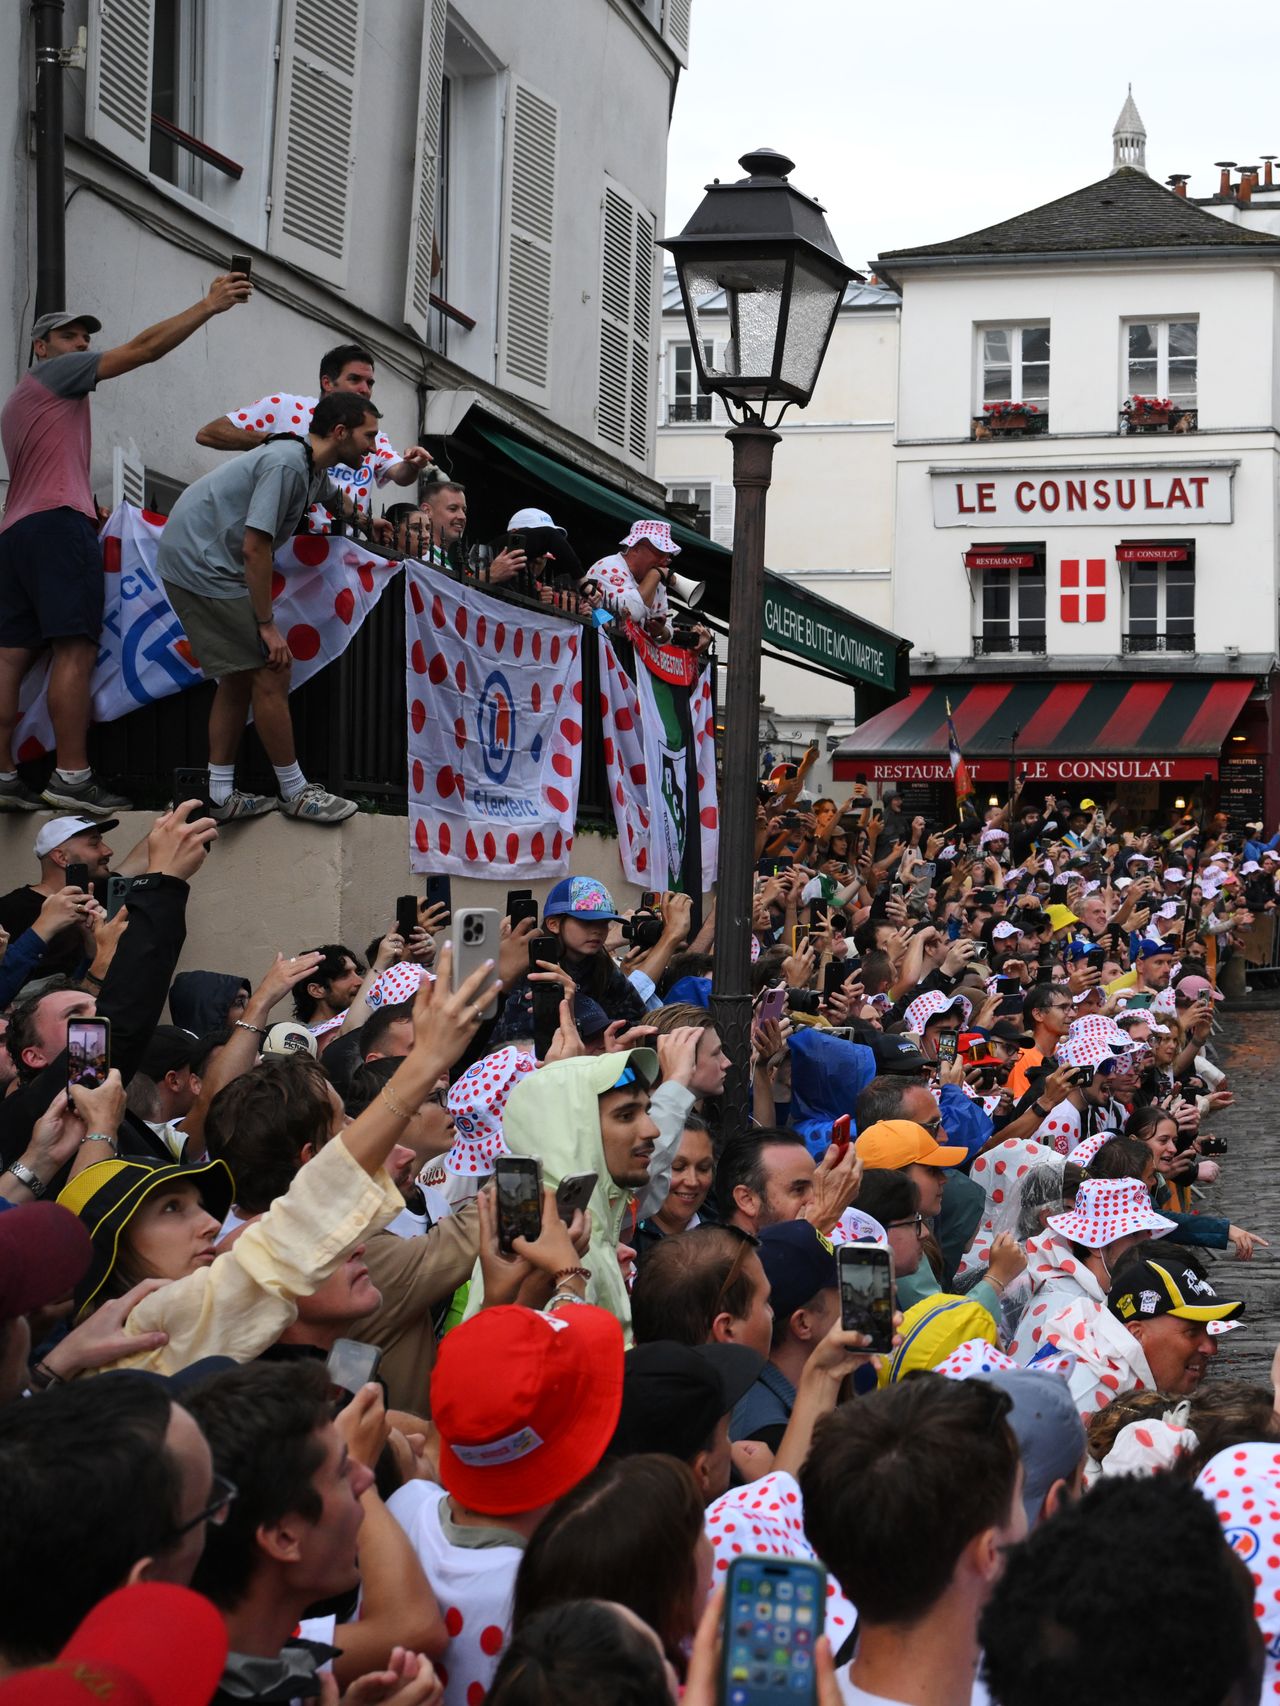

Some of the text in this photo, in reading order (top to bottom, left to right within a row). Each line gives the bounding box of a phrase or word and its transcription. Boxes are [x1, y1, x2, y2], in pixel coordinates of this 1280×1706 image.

[956, 477, 1209, 513] LE CONSULAT
[976, 557, 1023, 566] RESTAURANT
[1124, 550, 1178, 559] LE CONSULAT
[764, 599, 885, 677] GALERIE BUTTE MONTMARTRE
[660, 650, 684, 676] BRESTOIS
[1021, 762, 1048, 778] LE
[1057, 760, 1176, 779] CONSULAT
[473, 790, 539, 817] E.Leclerc
